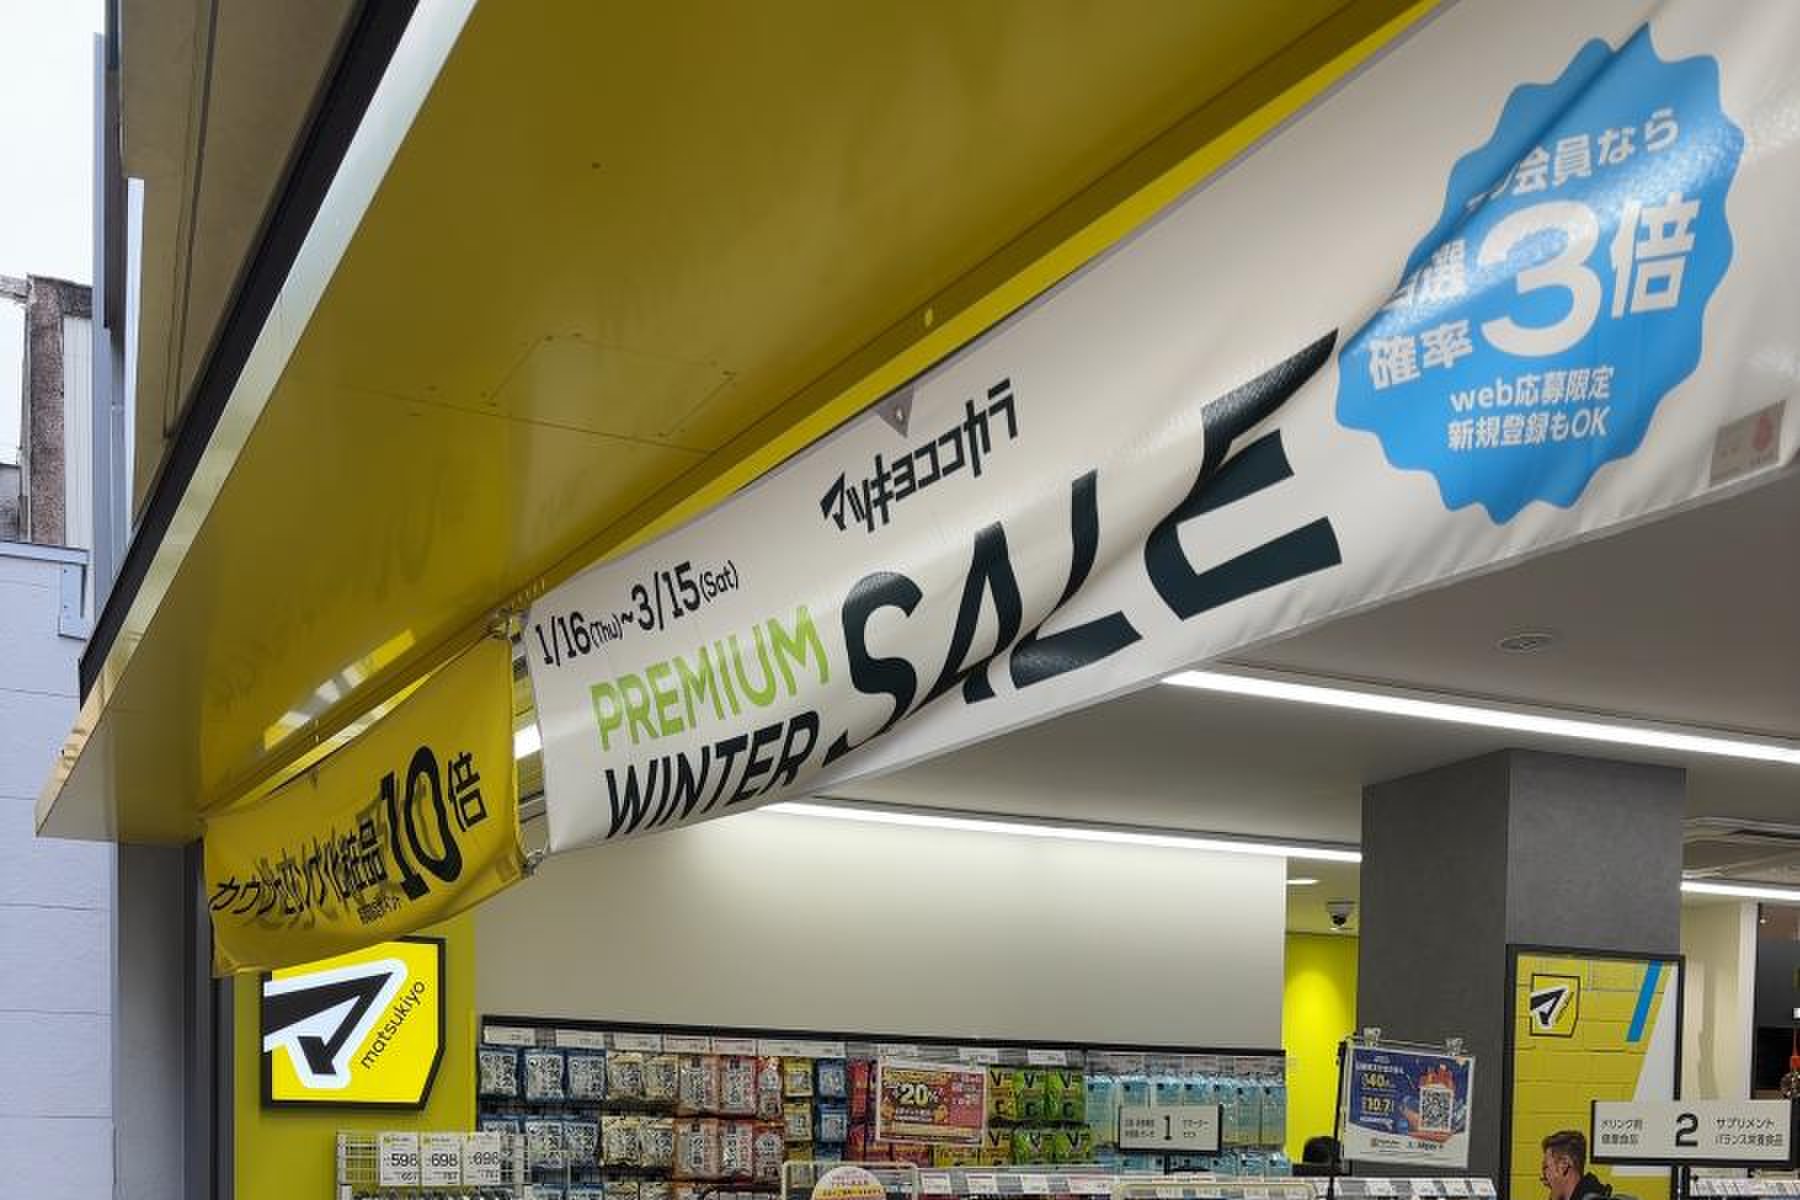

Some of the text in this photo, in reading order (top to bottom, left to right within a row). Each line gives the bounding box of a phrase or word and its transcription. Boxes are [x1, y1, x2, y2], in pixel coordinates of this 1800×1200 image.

[1468, 108, 1680, 208] 会員なら
[1367, 318, 1473, 392] 確率
[1450, 365, 1615, 413] web応募限定
[1447, 406, 1611, 452] 新規登録もOK
[823, 329, 1343, 768] SALE
[590, 603, 830, 753] PREMIUM
[603, 710, 821, 840] WINTER
[361, 979, 426, 1070] matsukiyo
[1163, 1114, 1172, 1141] 1
[1674, 1112, 1700, 1148] 2
[1715, 1117, 1776, 1130] サプリメント
[391, 1152, 419, 1168] 598
[431, 1152, 459, 1168] 698
[473, 1151, 501, 1168] 698
